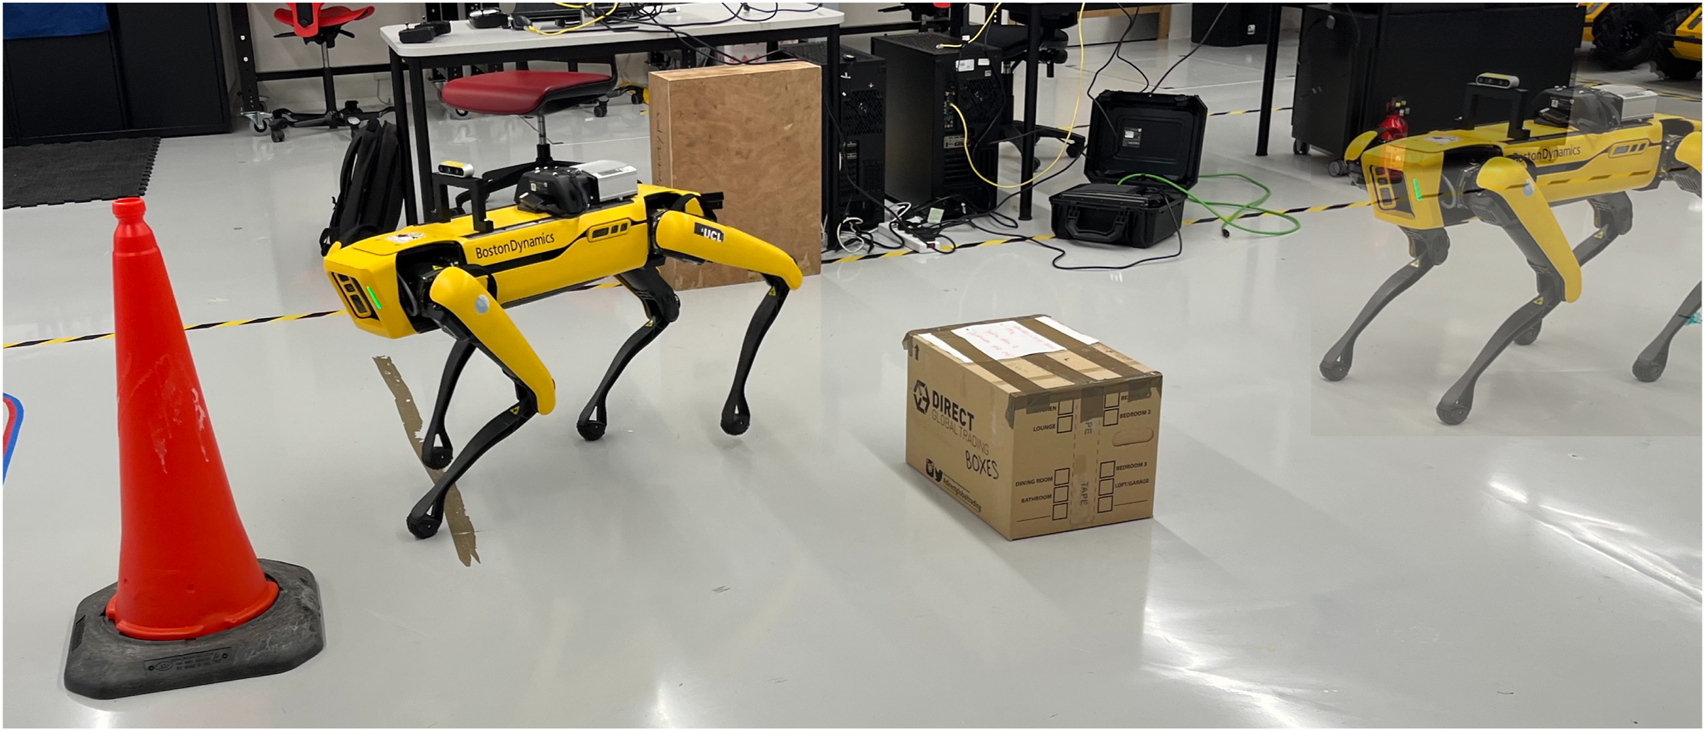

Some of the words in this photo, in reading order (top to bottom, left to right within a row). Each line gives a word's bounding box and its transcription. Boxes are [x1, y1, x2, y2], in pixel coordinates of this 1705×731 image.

[475, 233, 555, 260] BostonDynamics
[932, 389, 975, 432] DIRECT
[1120, 410, 1147, 419] BEDROOM
[1033, 423, 1056, 433] LOUNGE
[1084, 421, 1093, 435] PE
[965, 450, 1000, 480] BOXES
[1116, 462, 1143, 471] BEDROOM
[1015, 478, 1035, 487] DINING
[1036, 476, 1053, 484] ROOM
[1021, 493, 1052, 503] BATHROOM
[1080, 481, 1089, 506] TAPE
